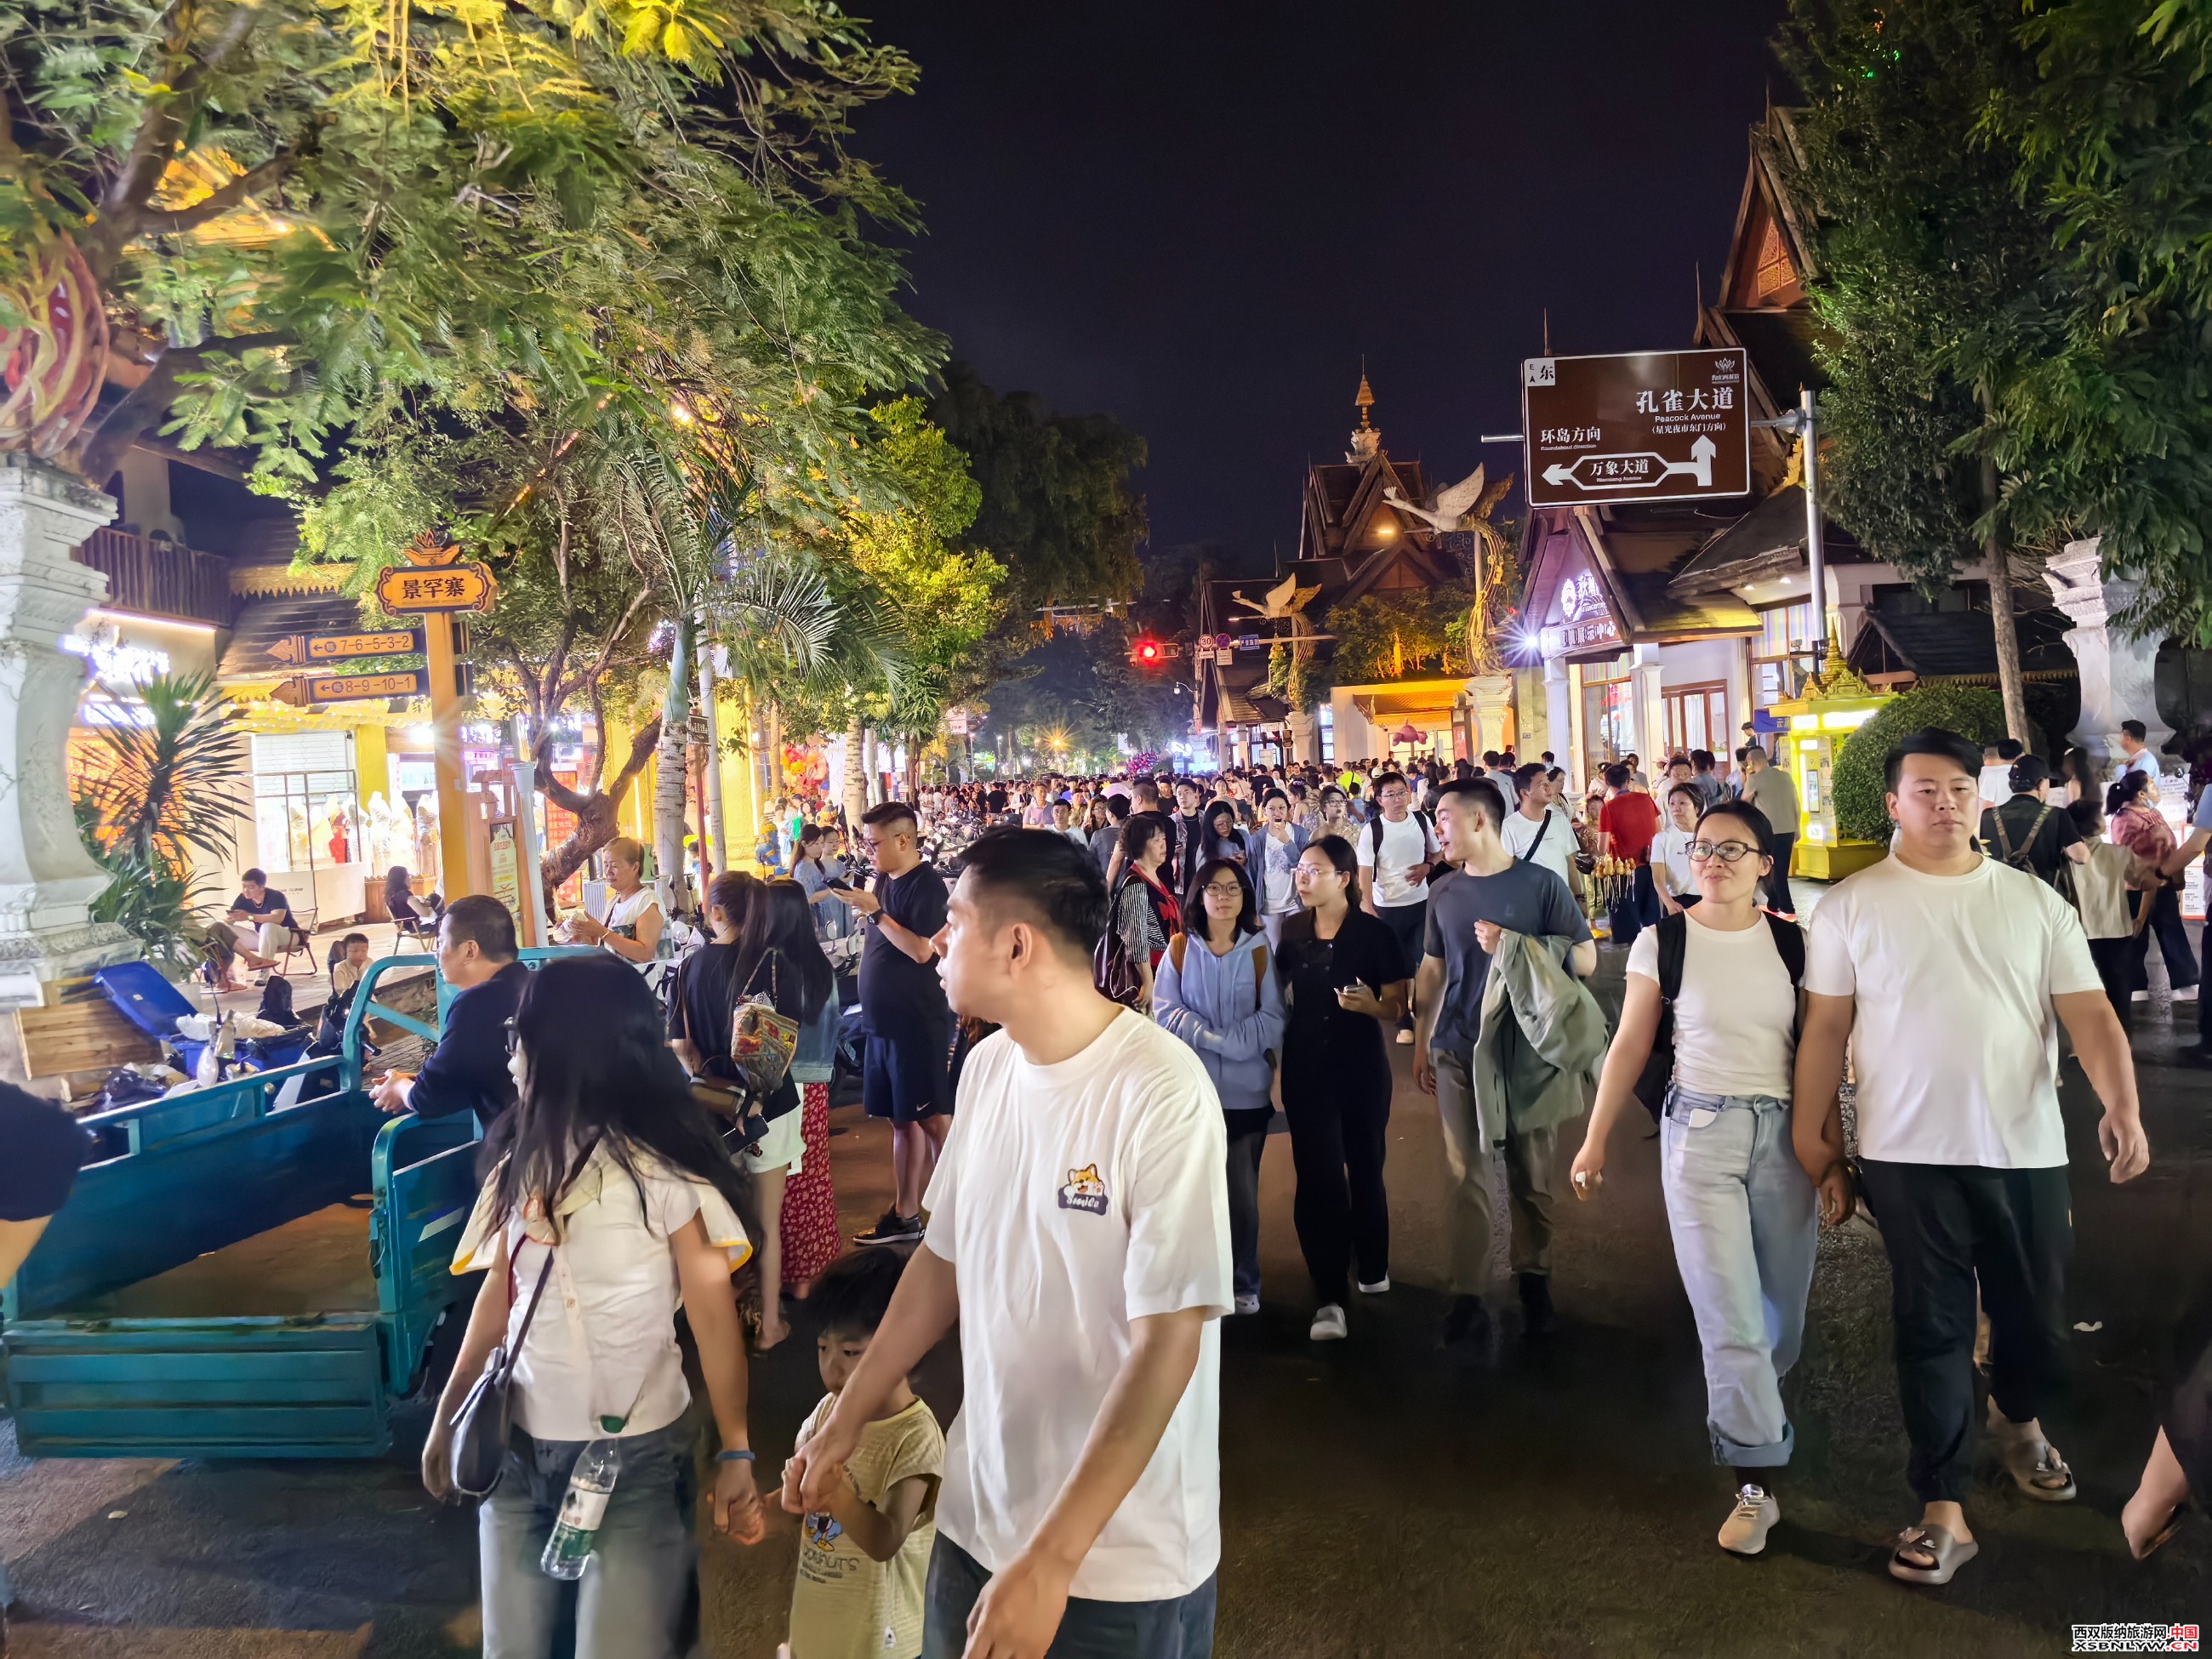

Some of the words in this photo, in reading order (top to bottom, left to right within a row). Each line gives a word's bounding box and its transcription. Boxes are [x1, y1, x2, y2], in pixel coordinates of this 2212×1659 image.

[1540, 365, 1554, 380] 东
[1635, 386, 1734, 414] 孔雀大道
[1655, 414, 1689, 423] Peacock
[1690, 413, 1721, 421] Avenue
[1541, 425, 1601, 444] 环岛方向
[1589, 459, 1649, 476] 万象大道
[402, 577, 465, 599] 景罕寨
[340, 635, 409, 653] 7-6-5-3-2
